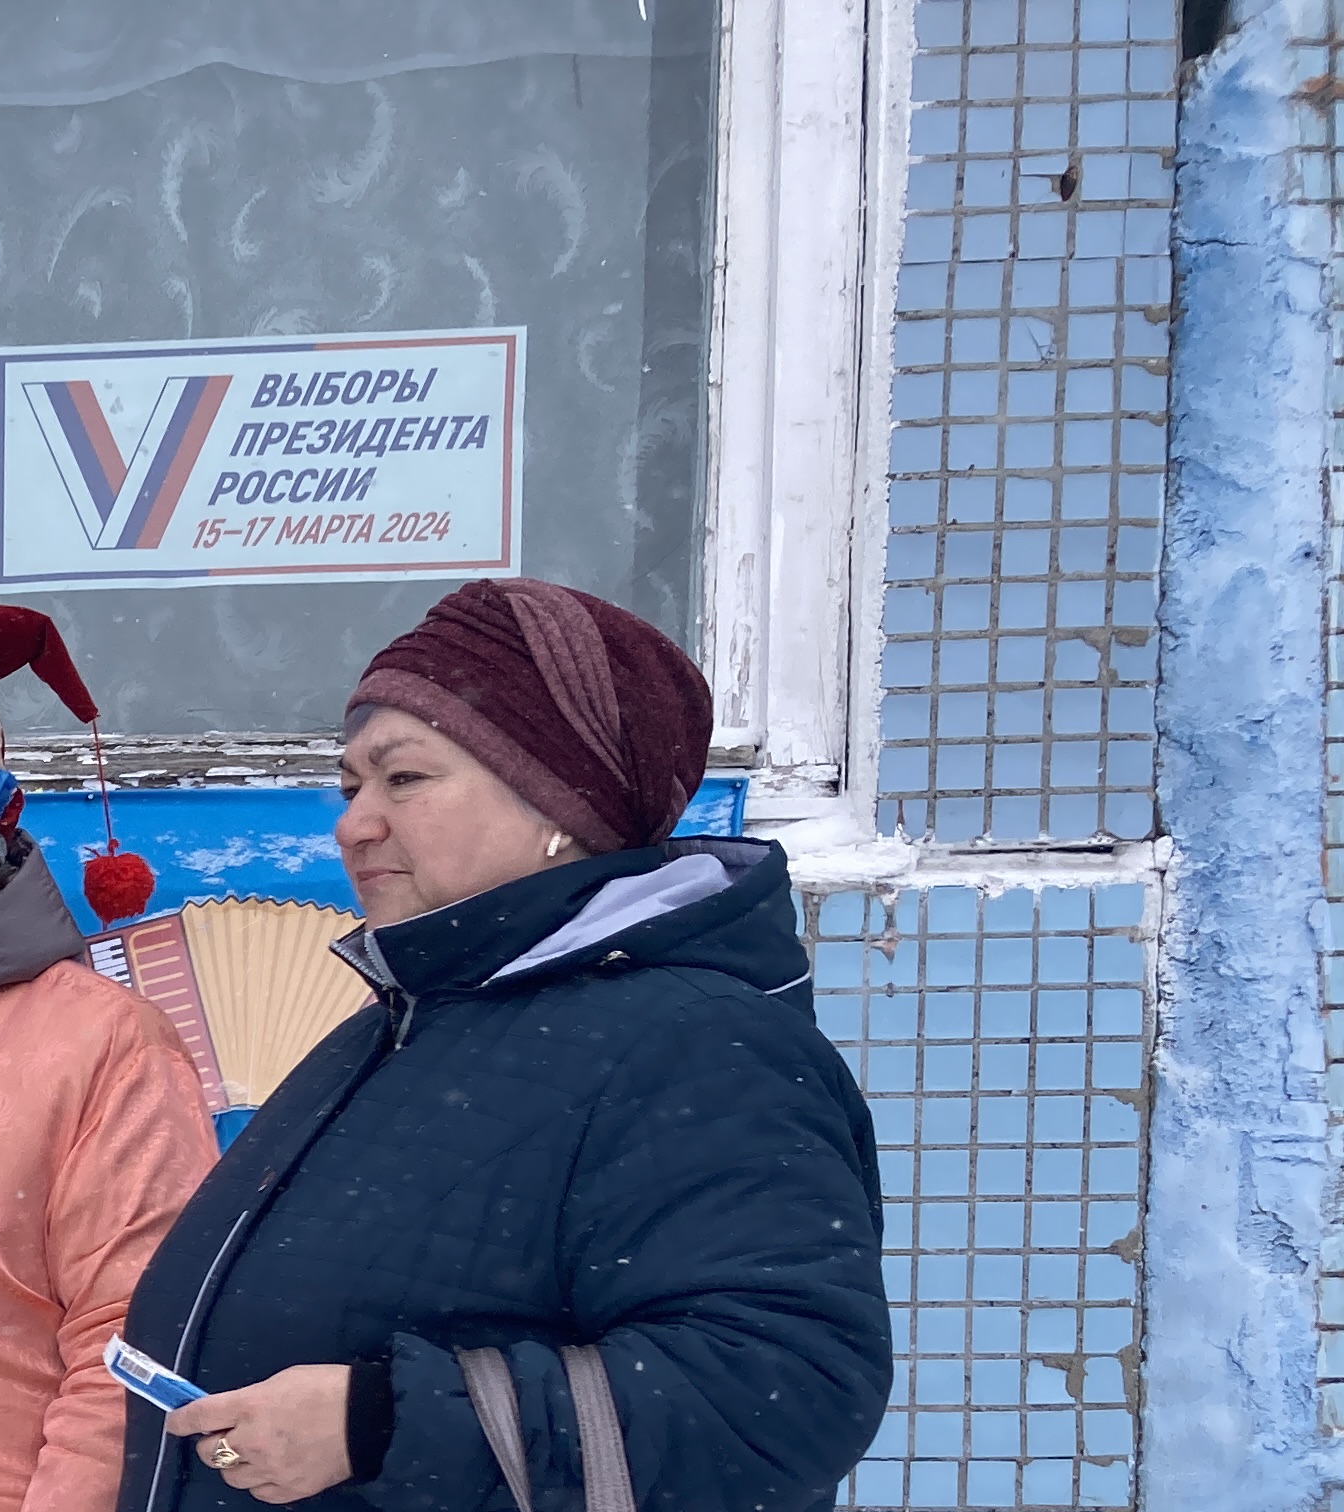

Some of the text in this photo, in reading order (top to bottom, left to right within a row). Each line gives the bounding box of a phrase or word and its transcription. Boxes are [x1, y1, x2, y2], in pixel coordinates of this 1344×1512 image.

[250, 367, 438, 409] ВЫБОРЫ
[229, 415, 490, 458] ПРЕЗИДЕНТА
[208, 467, 377, 506] РОССИИ
[275, 513, 374, 547] МАРТА
[378, 511, 451, 544] 2024
